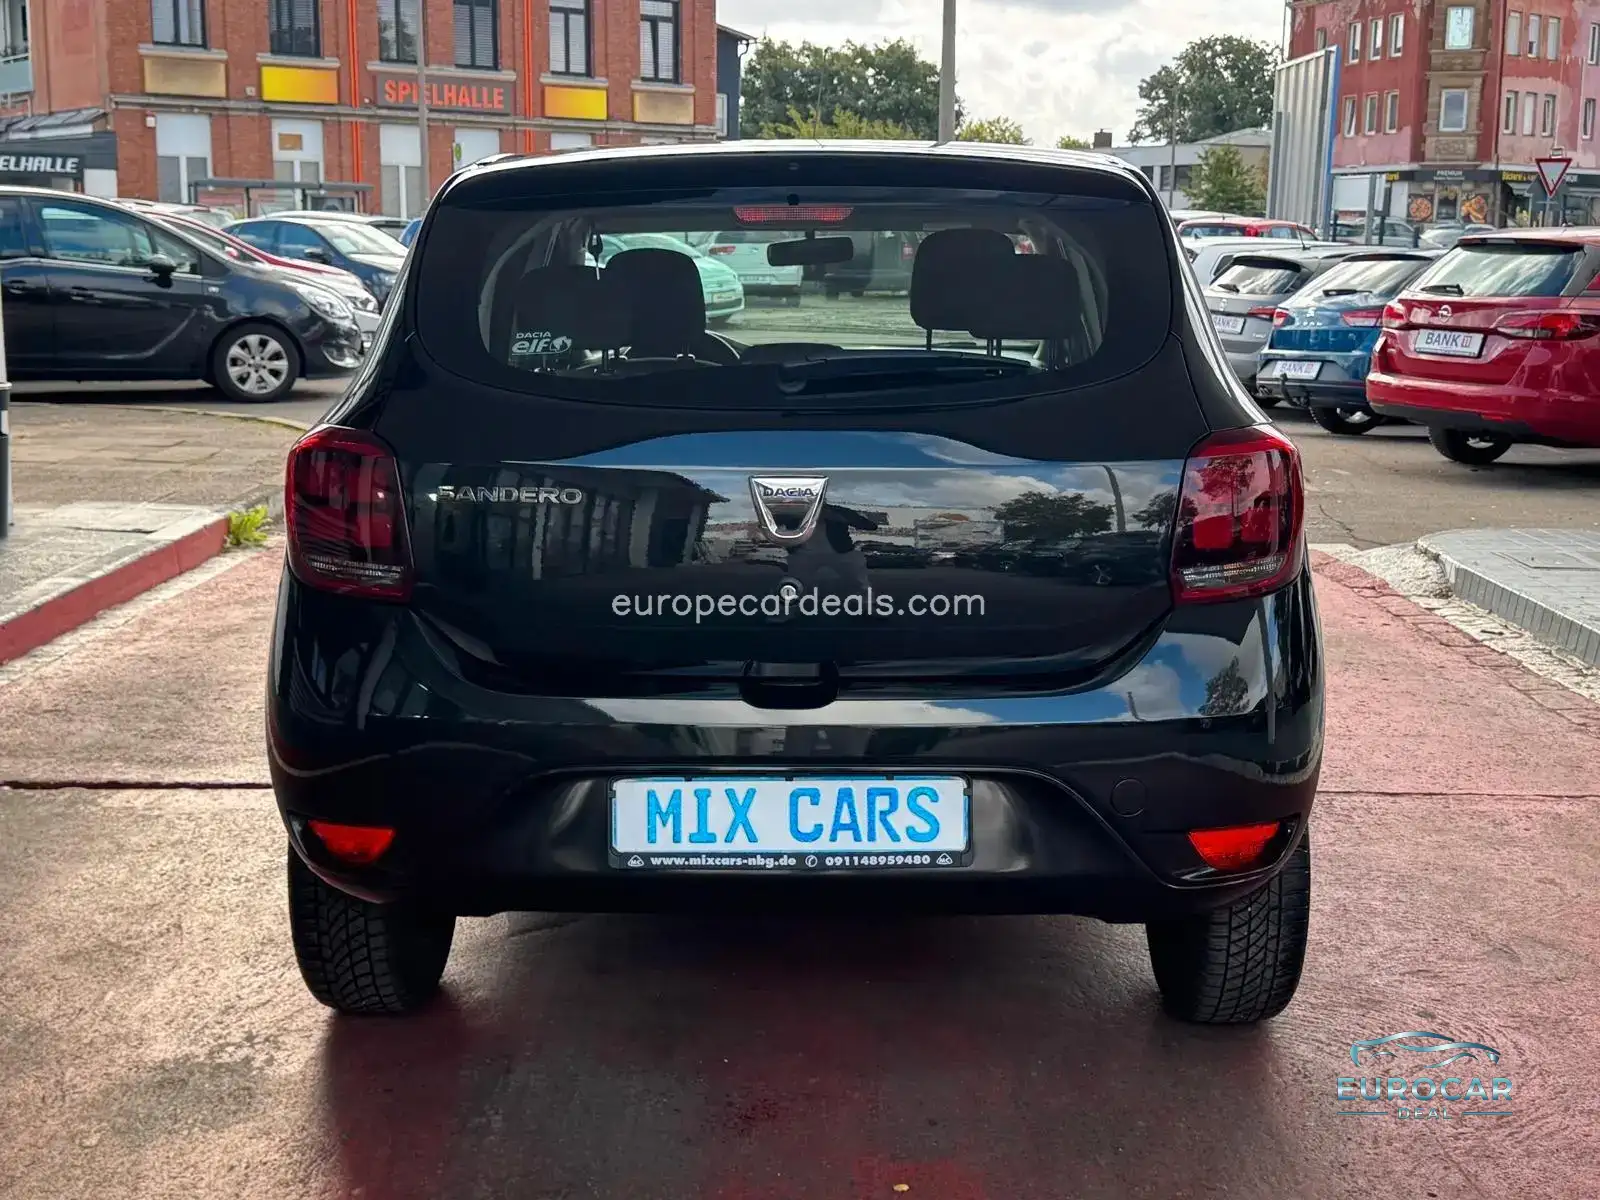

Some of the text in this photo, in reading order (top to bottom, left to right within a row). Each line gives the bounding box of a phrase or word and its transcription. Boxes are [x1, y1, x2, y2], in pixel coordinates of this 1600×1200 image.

[384, 79, 505, 109] SPIELHALLE
[515, 331, 552, 339] DACIA
[1425, 332, 1461, 348] BANK
[511, 338, 551, 353] elf
[436, 485, 583, 505] SANDERO
[763, 487, 814, 497] DACIA
[646, 786, 940, 844] MIX CARS
[650, 854, 797, 868] www.mixcars-nbg.de
